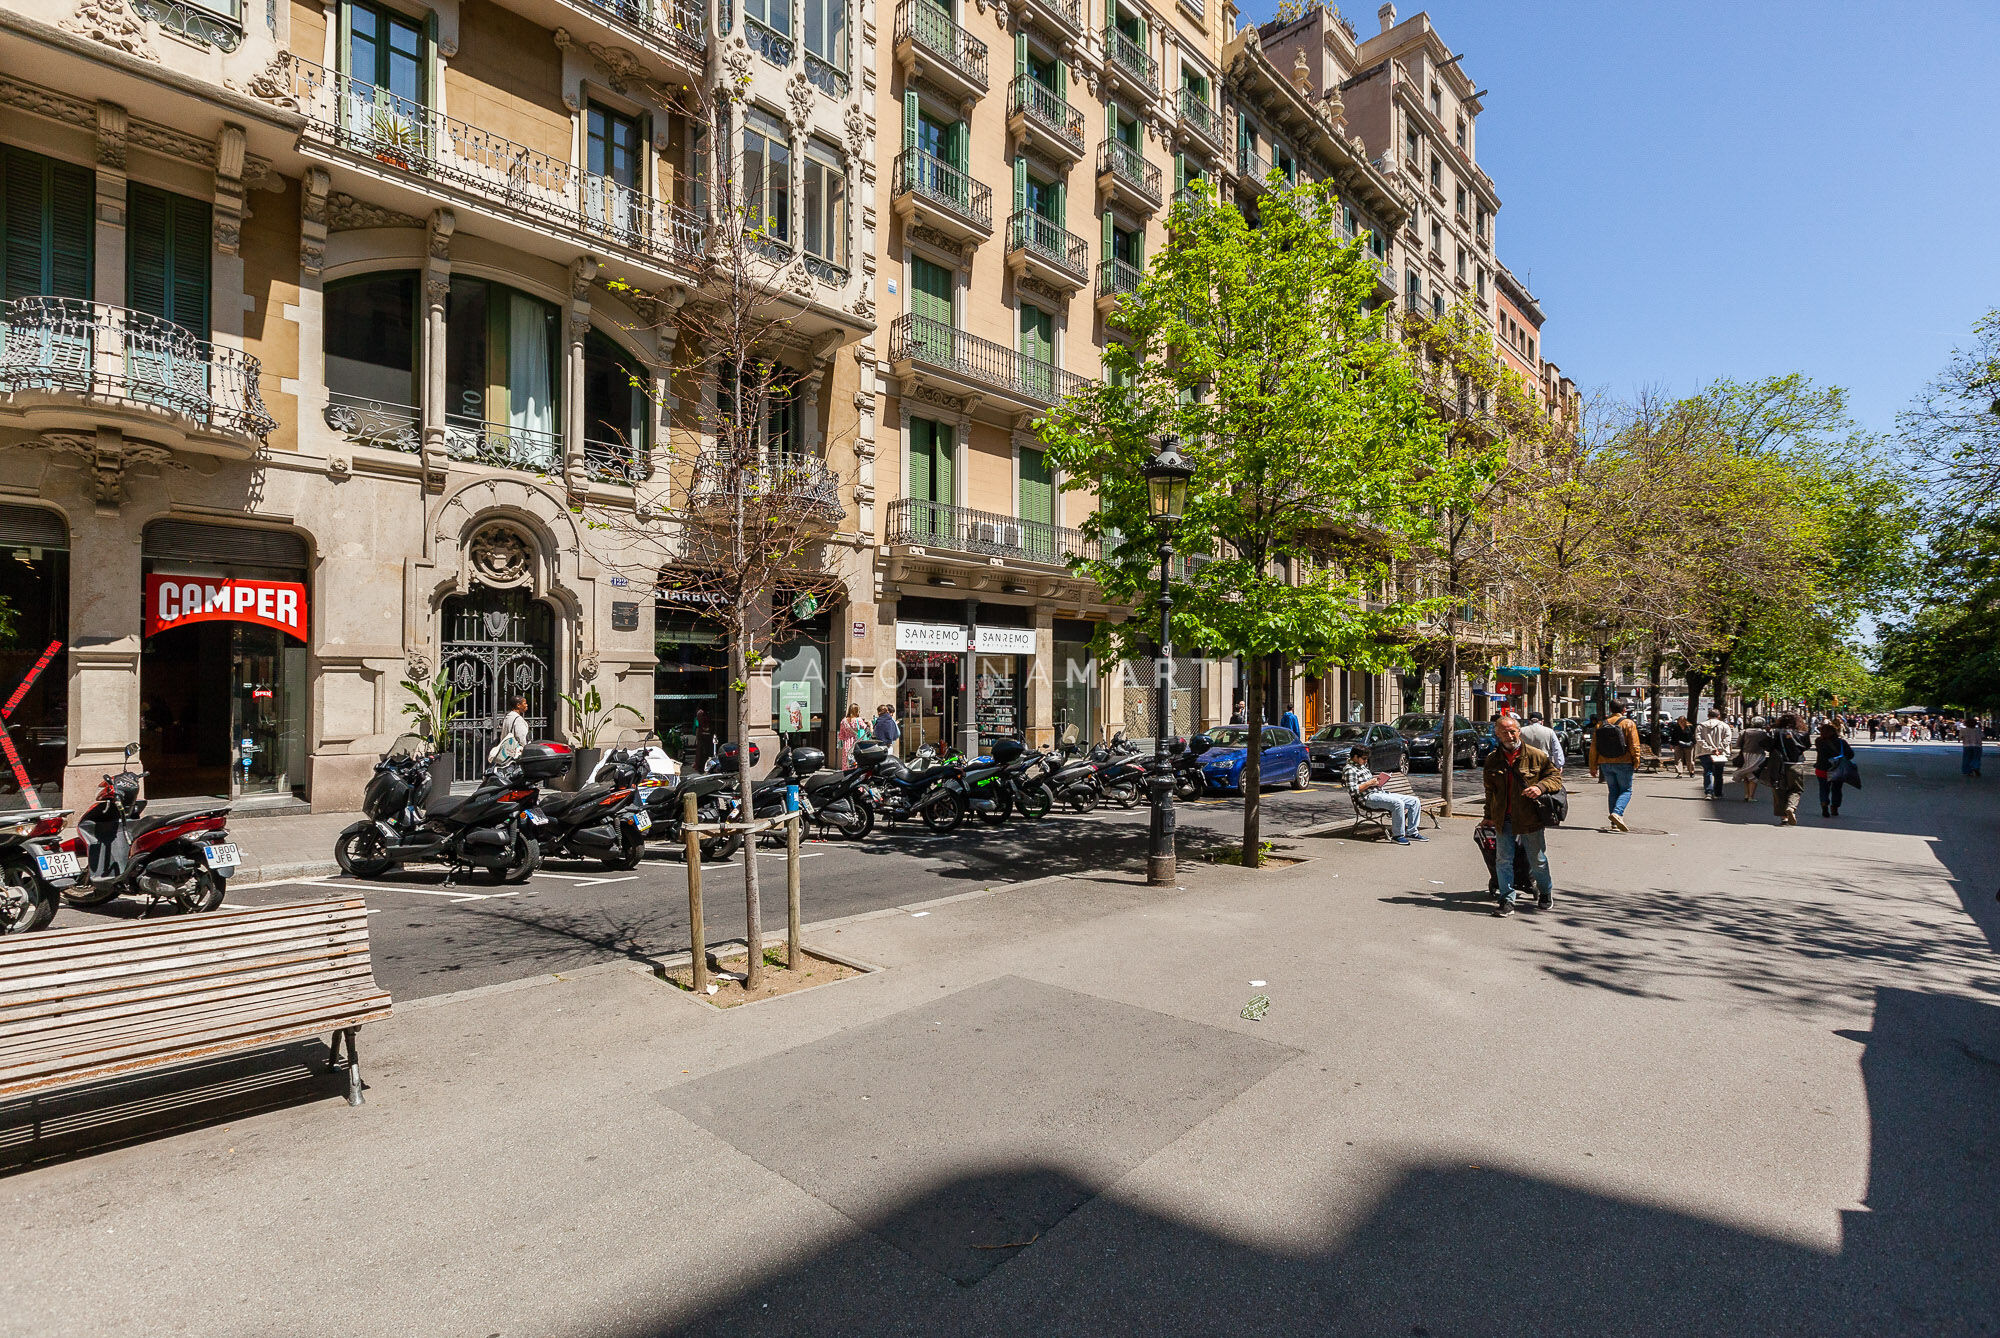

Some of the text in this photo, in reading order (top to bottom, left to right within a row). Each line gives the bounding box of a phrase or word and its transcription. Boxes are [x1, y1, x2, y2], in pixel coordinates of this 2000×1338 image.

[614, 578, 627, 586] 122
[159, 582, 298, 628] CAMPER
[905, 628, 959, 641] SANREMO
[982, 632, 1029, 644] SANREMO
[213, 845, 236, 855] 1800
[46, 853, 73, 865] 7821
[216, 853, 232, 863] JFB
[50, 863, 69, 875] DVF
